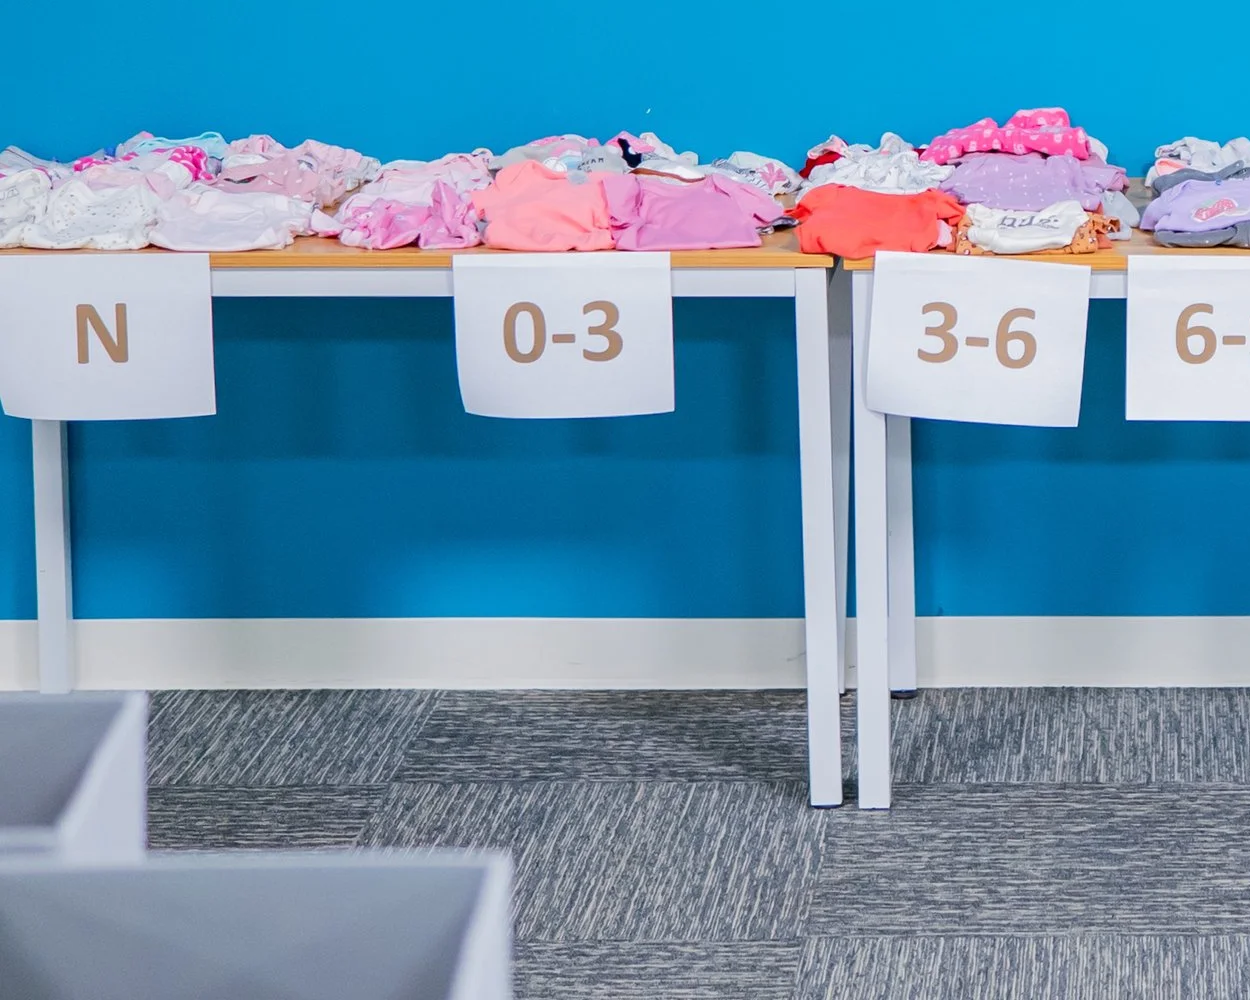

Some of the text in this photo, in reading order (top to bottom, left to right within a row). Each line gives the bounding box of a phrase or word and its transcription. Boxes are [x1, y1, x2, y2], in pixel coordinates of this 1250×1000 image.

[75, 304, 129, 364] N
[503, 301, 624, 364] 0-3
[917, 302, 1037, 369] 3-6
